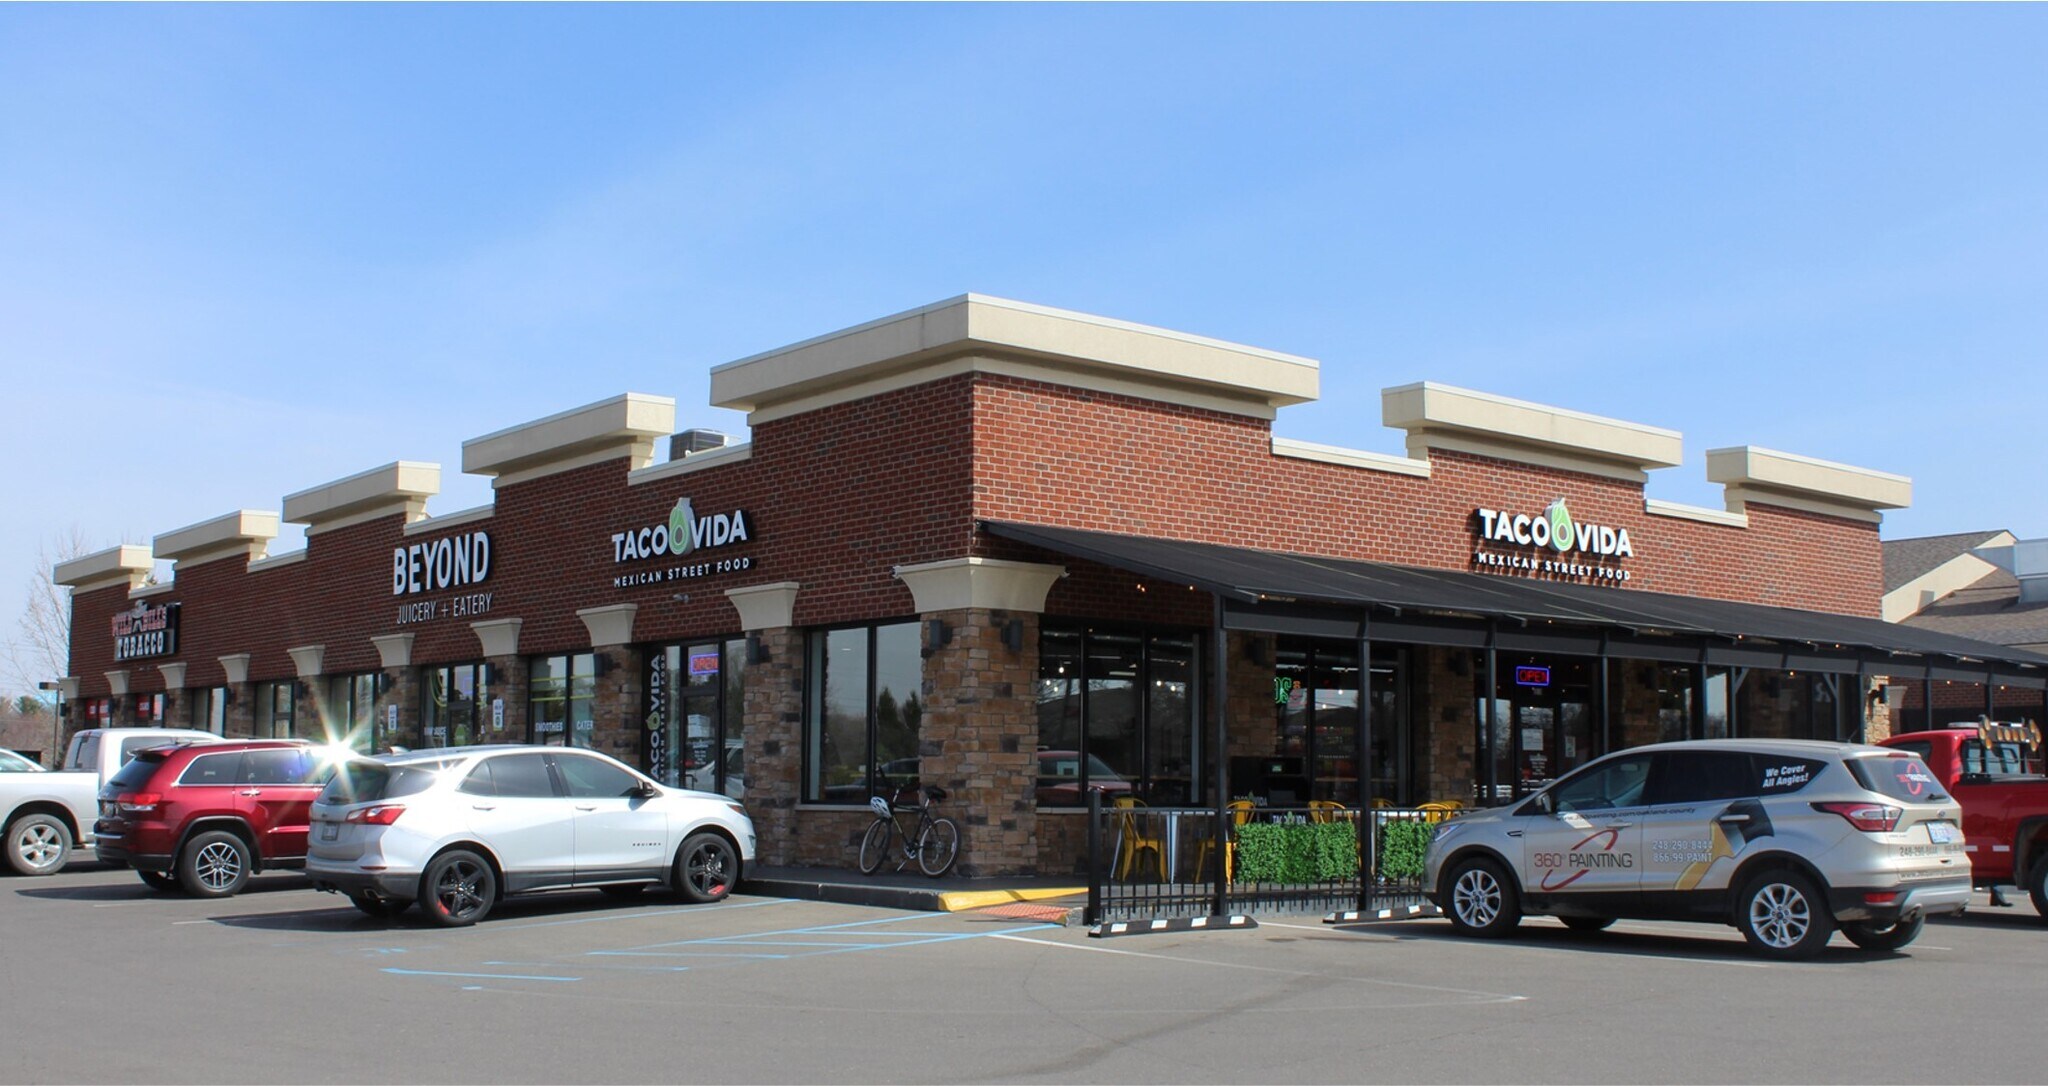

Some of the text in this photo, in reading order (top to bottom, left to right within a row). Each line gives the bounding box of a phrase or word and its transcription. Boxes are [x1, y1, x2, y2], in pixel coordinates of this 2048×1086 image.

[612, 509, 747, 563] TACO VIDA
[1479, 508, 1634, 557] TACO VIDA
[393, 531, 489, 595] BEYOND
[614, 557, 750, 588] MEXICAN STREET FOOD
[1478, 552, 1631, 581] MEXICAN STREET FOOD
[396, 601, 436, 625] JUICERY
[453, 593, 493, 617] EATERY
[117, 631, 164, 658] TOBACCO
[1519, 669, 1548, 682] OPEN
[535, 722, 564, 732] SMOOTHIES
[650, 655, 660, 780] ACO VIDA
[1763, 773, 1809, 788] All Angles!
[1765, 765, 1806, 778] We Cover
[1569, 852, 1633, 868] PAINTING
